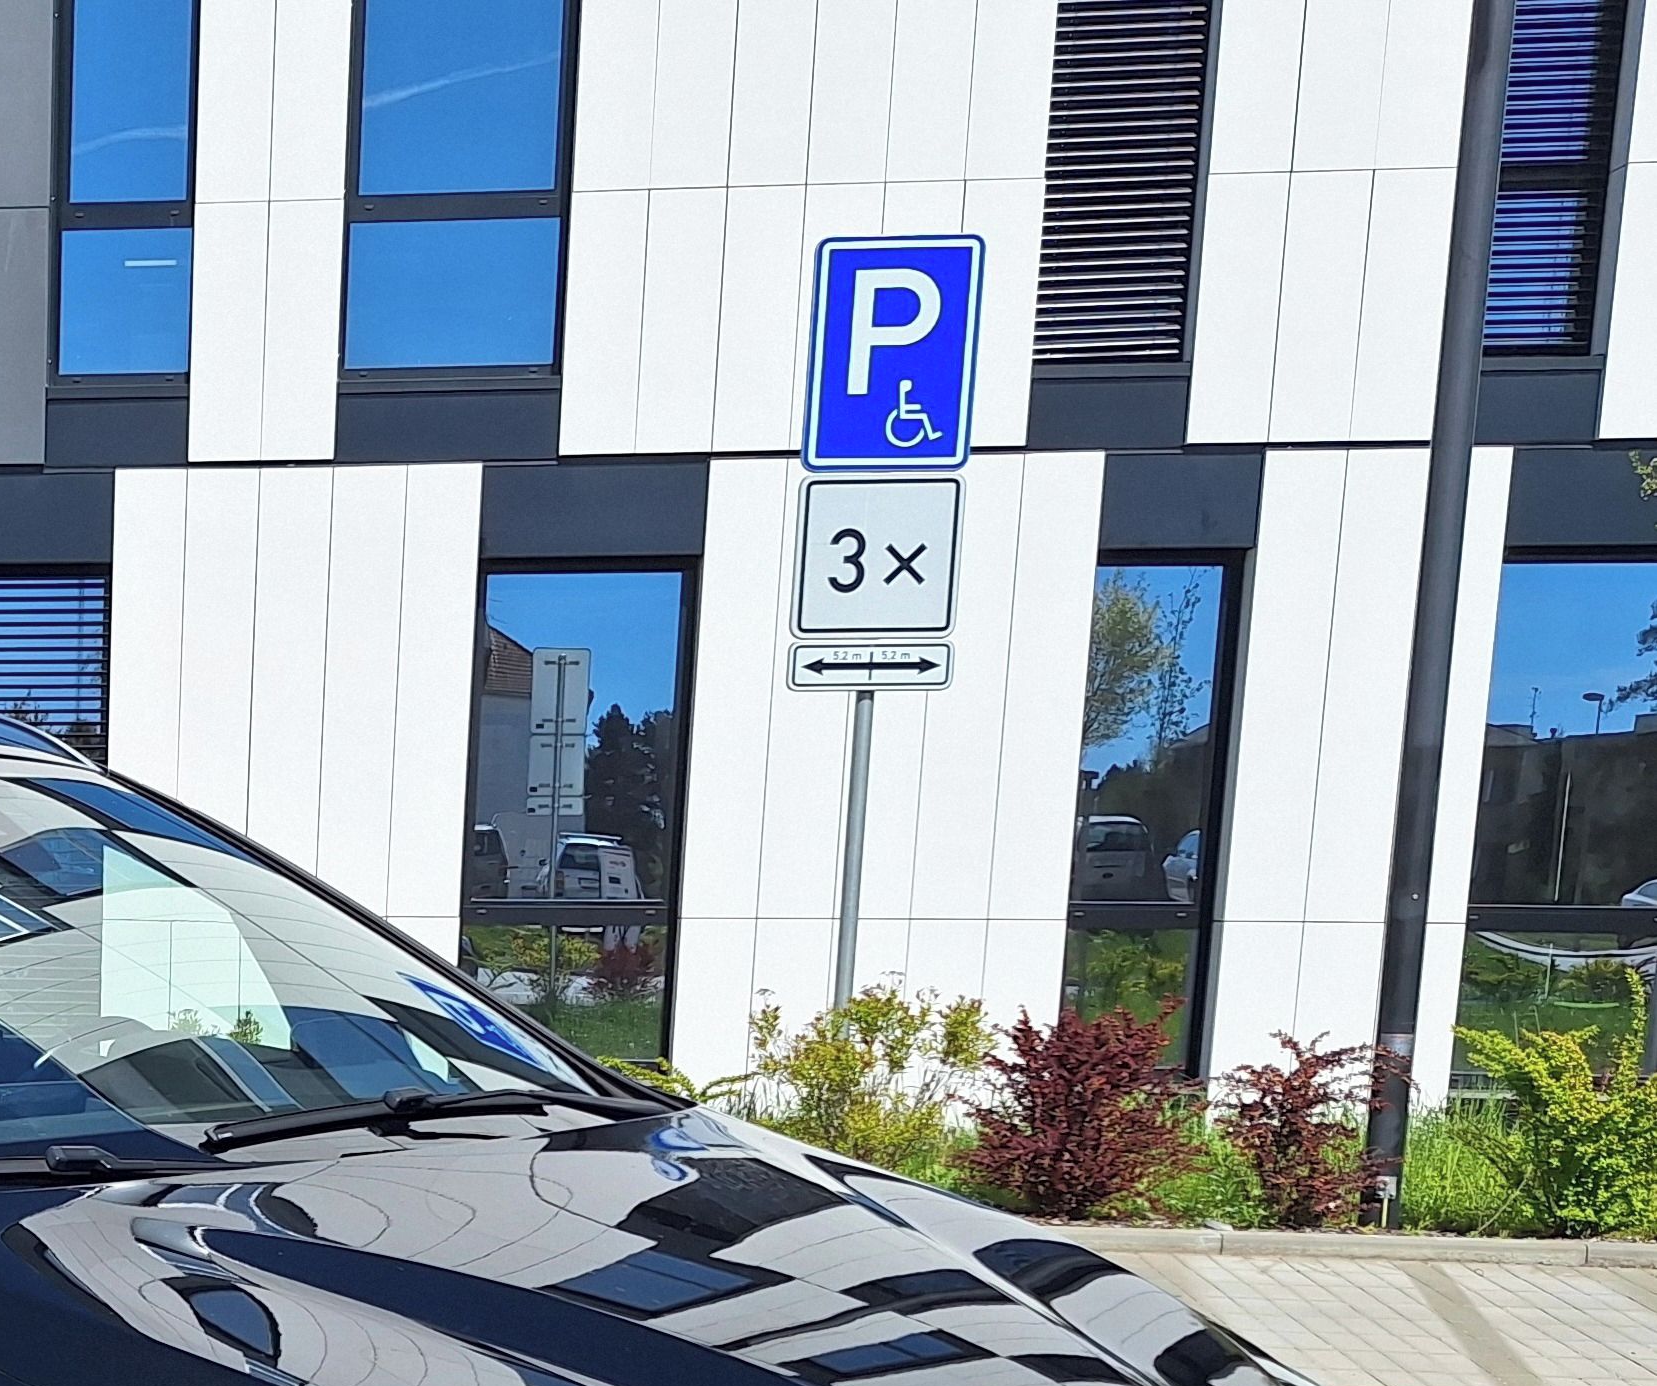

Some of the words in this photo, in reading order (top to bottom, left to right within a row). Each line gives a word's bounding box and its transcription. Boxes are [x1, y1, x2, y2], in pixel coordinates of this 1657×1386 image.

[847, 268, 941, 395] P
[852, 652, 862, 660] m
[900, 652, 911, 660] m
